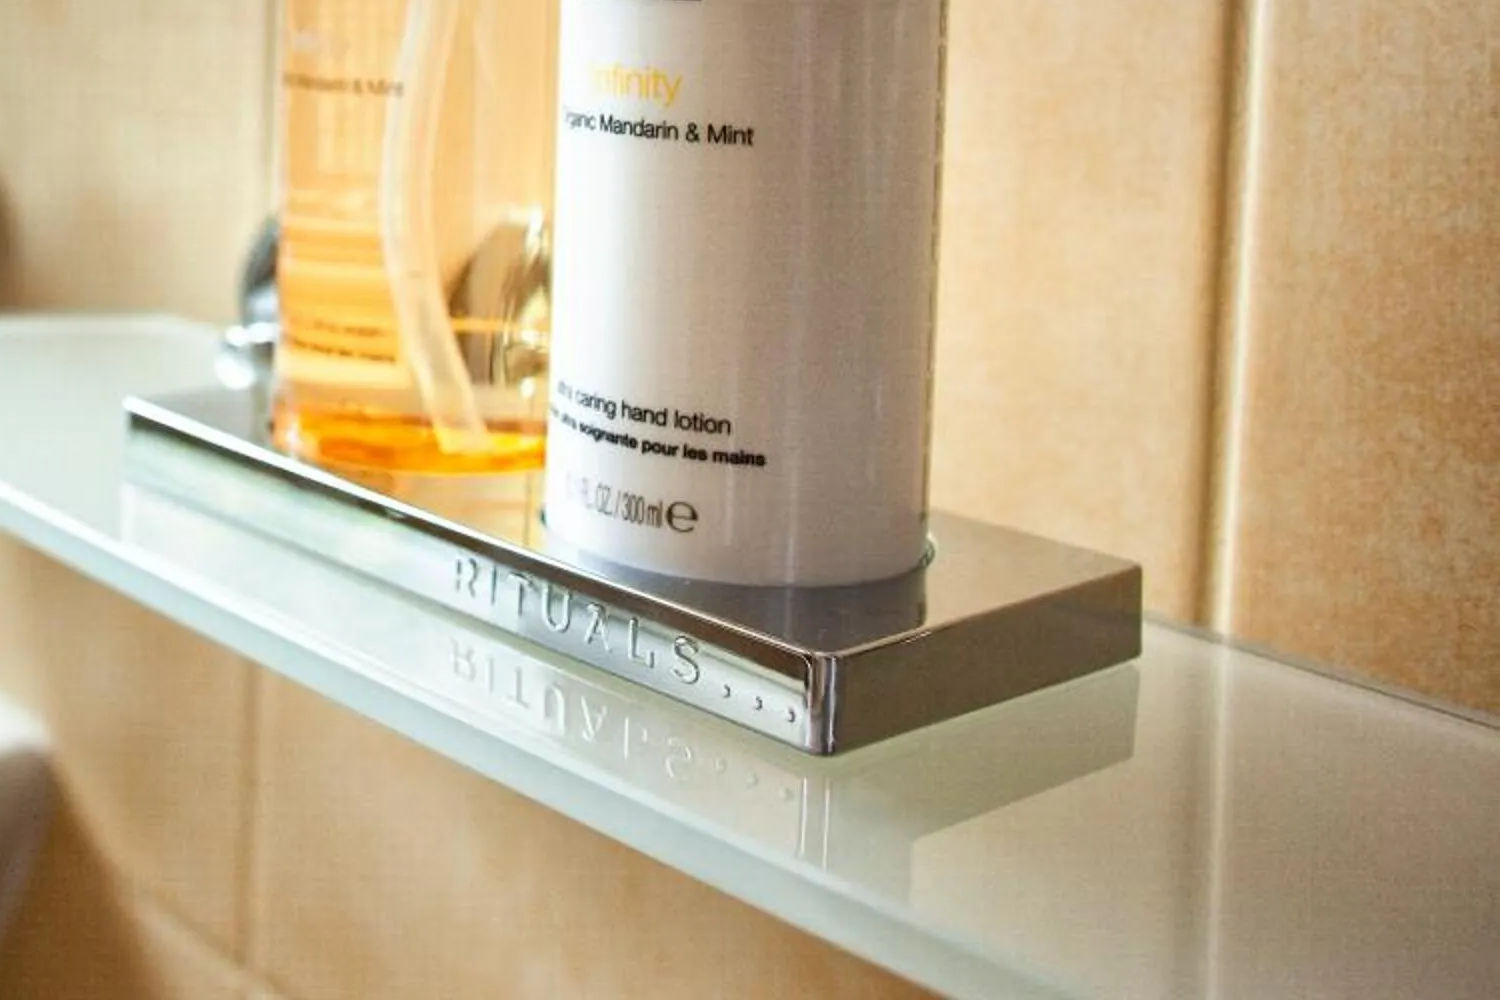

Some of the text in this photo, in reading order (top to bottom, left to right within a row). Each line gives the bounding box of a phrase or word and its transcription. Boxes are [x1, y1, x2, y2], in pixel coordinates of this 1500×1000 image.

[599, 113, 679, 141] Mandarin
[685, 121, 701, 143] &
[707, 123, 755, 147] Mint
[575, 389, 617, 420] caring
[621, 400, 669, 428] hand
[674, 410, 732, 436] lotion
[579, 421, 638, 449] soignante
[642, 439, 679, 456] pour
[683, 444, 708, 461] les
[712, 450, 767, 467] mains
